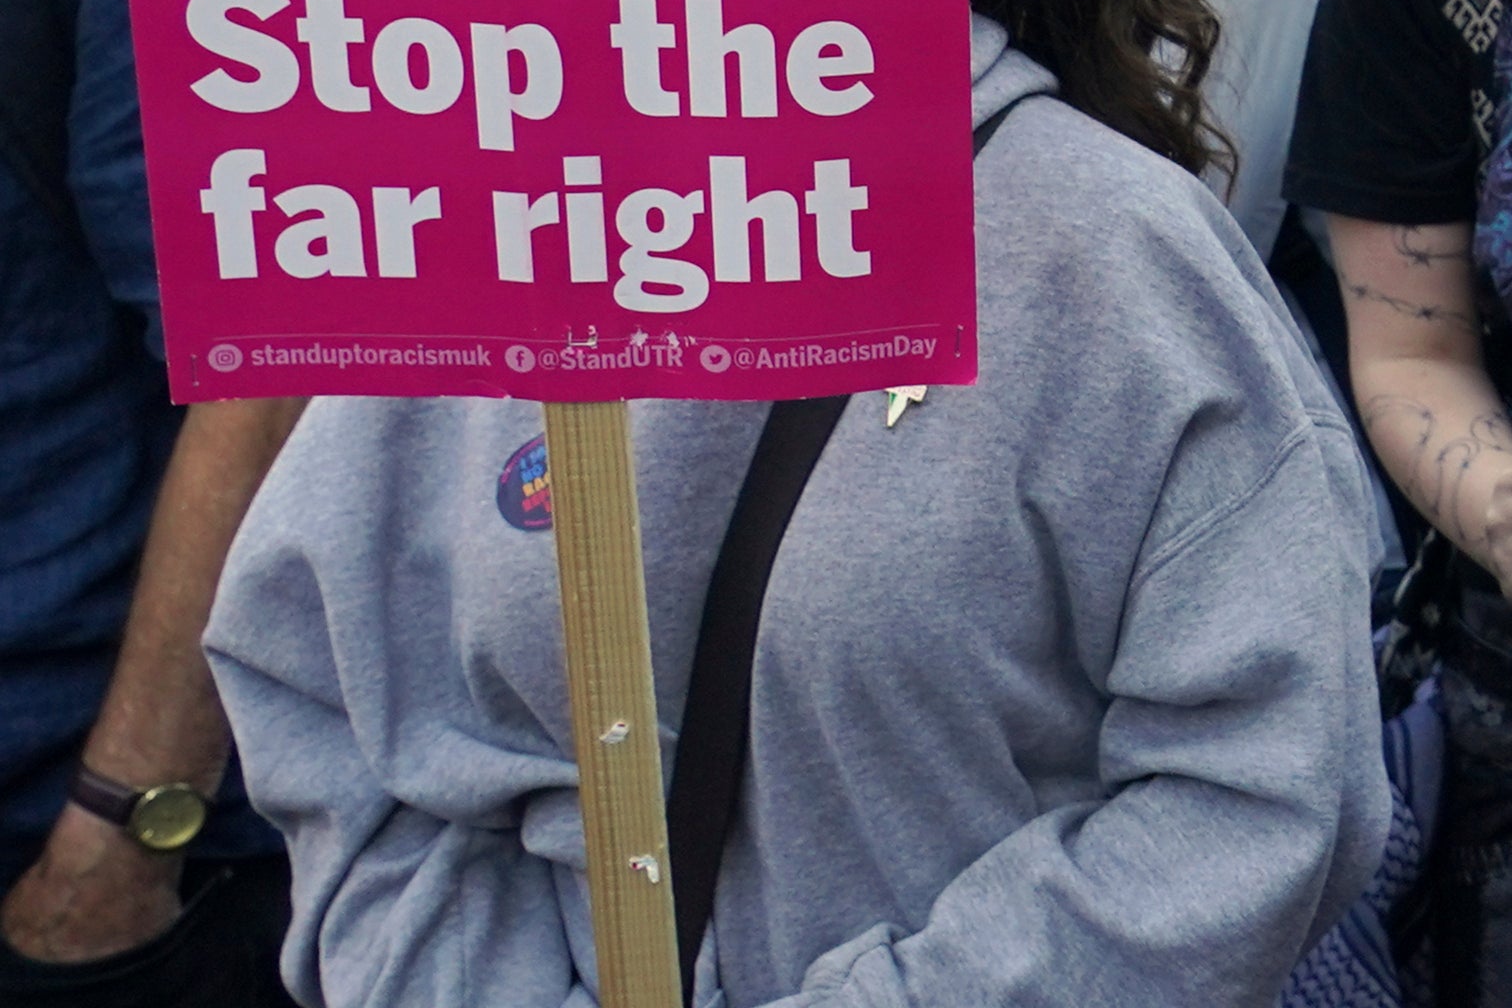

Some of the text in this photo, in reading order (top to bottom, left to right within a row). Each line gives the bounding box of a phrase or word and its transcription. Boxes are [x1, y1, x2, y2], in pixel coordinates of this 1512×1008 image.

[200, 149, 871, 313] far right
[252, 336, 937, 372] standuptoracismuk @StandUTR @AntiRacismDay
